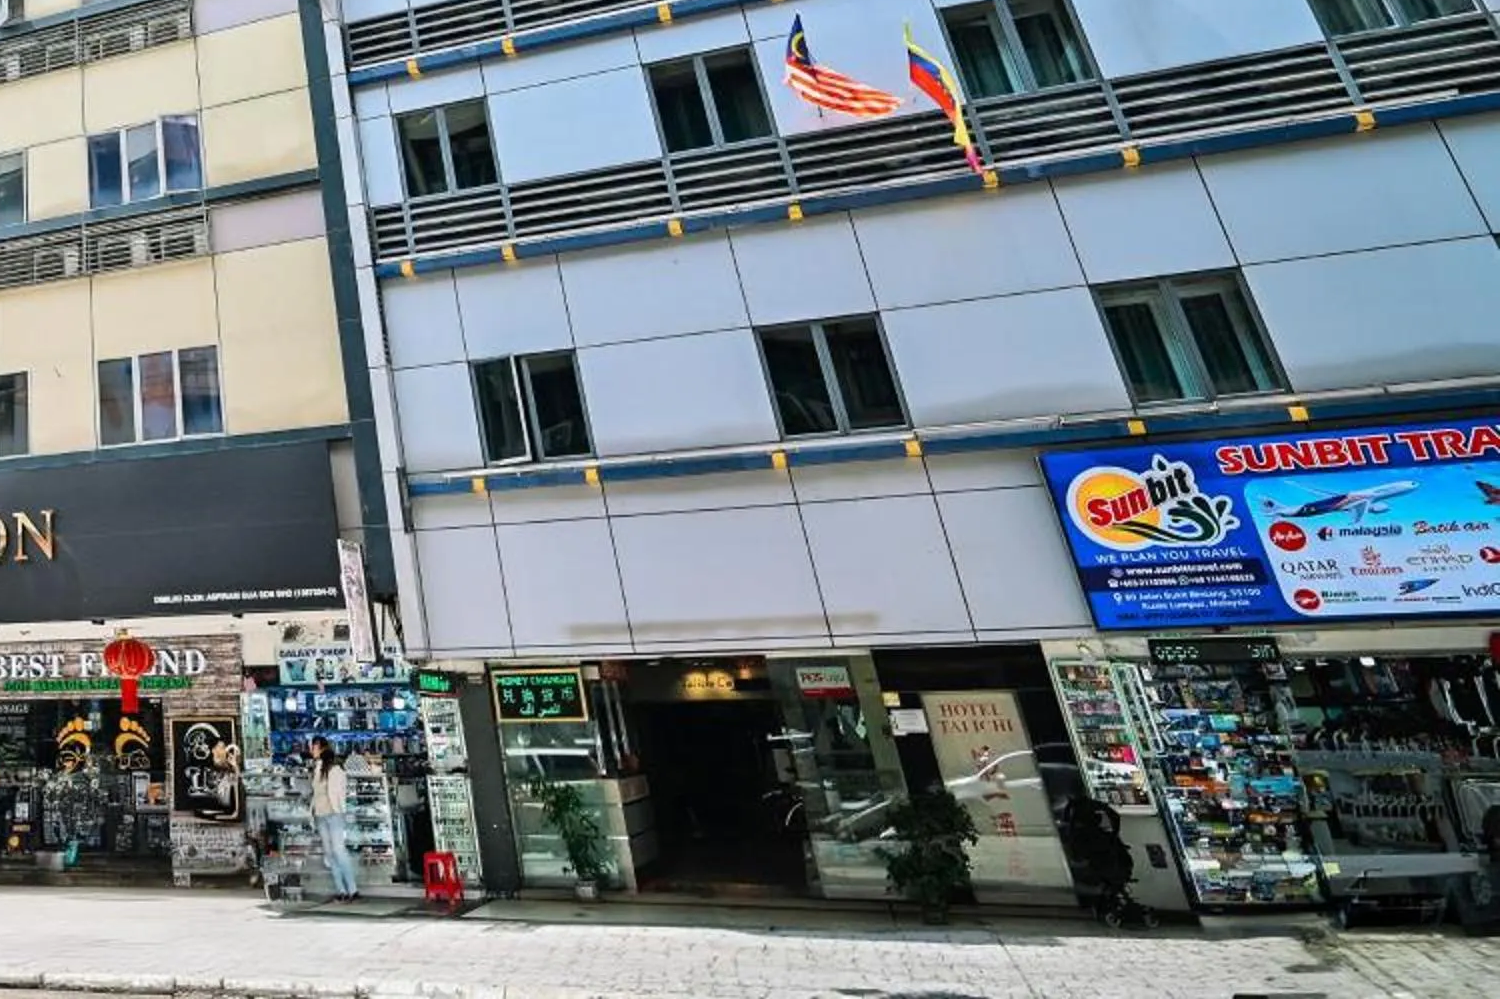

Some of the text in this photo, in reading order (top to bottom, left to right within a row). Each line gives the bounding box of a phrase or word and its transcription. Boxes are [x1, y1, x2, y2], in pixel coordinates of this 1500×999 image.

[1216, 425, 1500, 475] SUNBIT TRA
[1087, 468, 1191, 526] Sunbit
[1340, 524, 1402, 537] malaysia
[1095, 547, 1248, 564] WE PLAN YOU TRAVEL
[1281, 559, 1339, 575] QATAR
[80, 648, 207, 680] FND
[940, 703, 1003, 717] HOTEL
